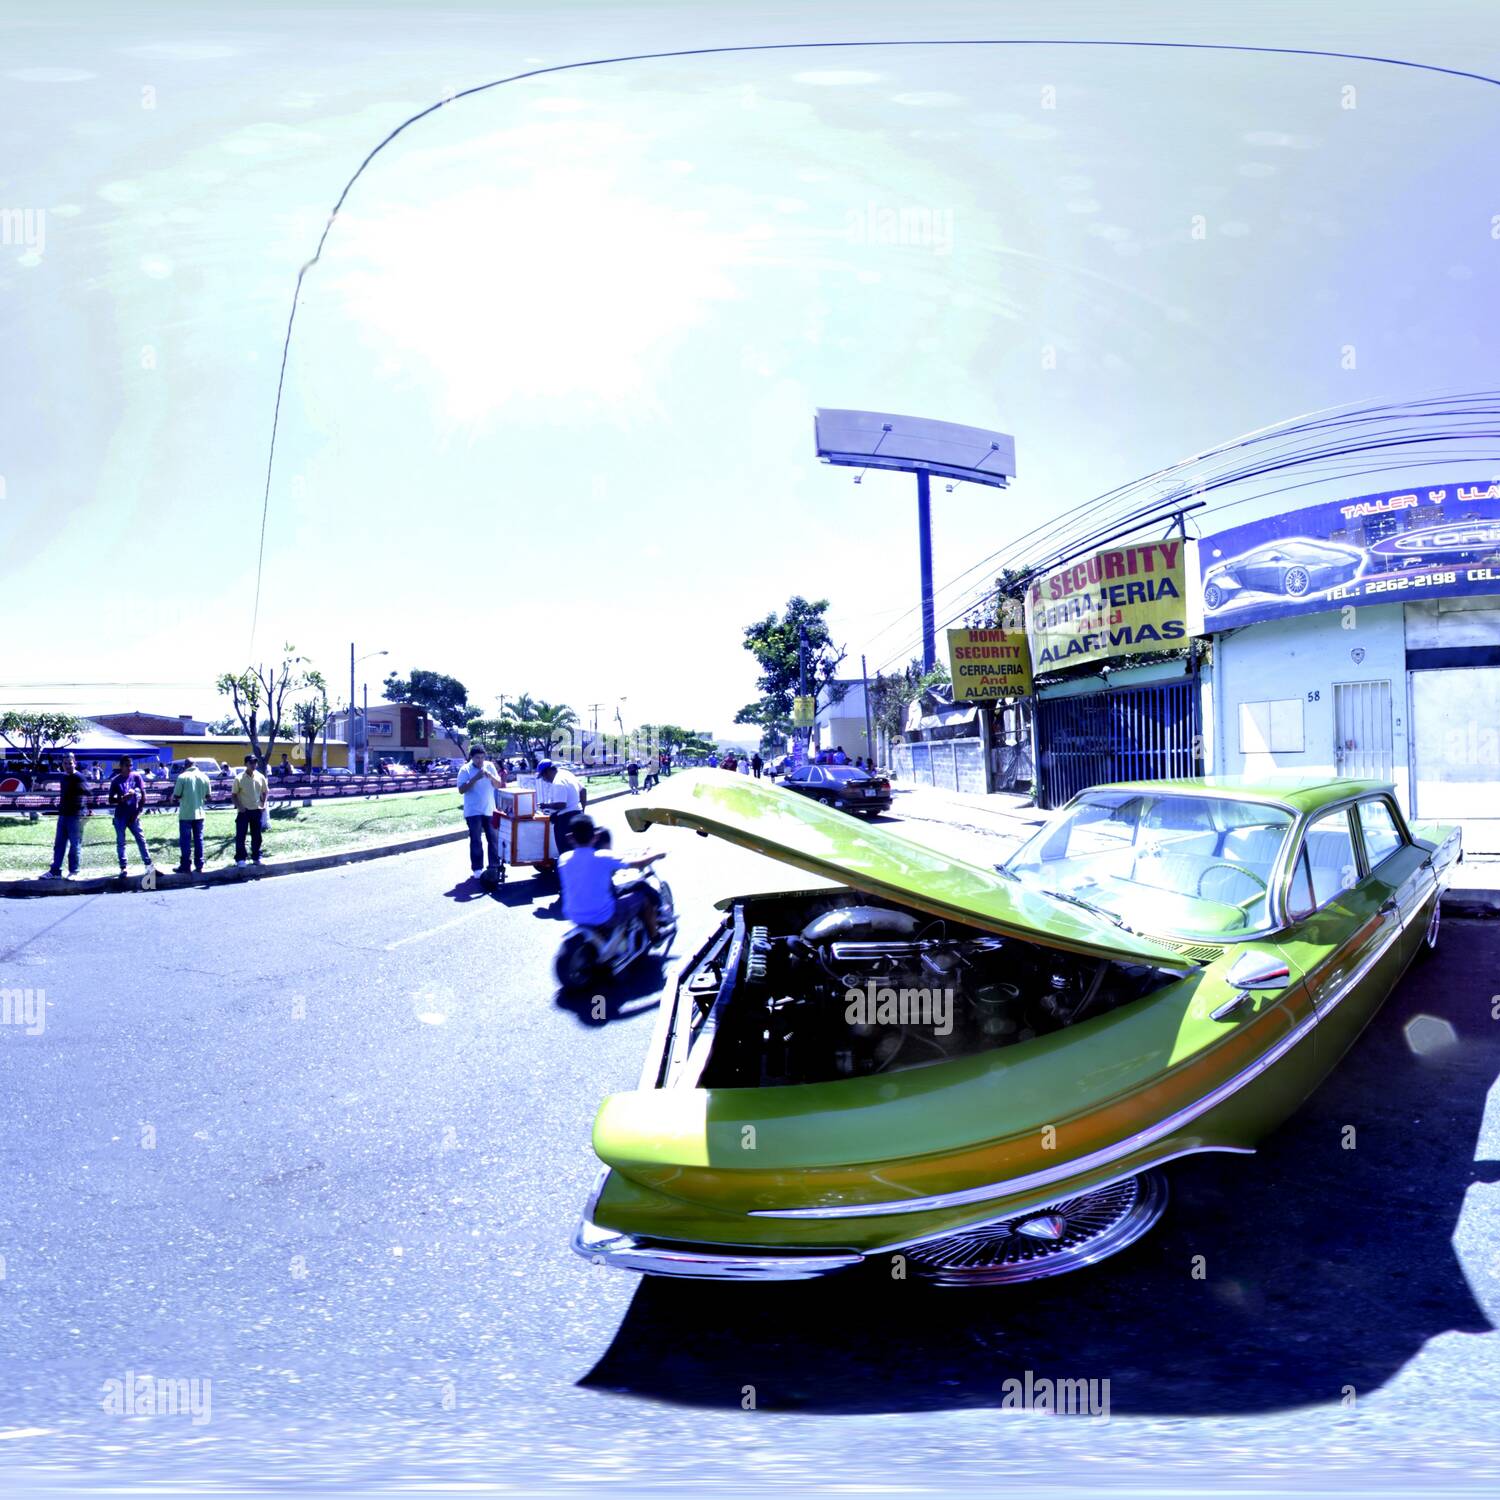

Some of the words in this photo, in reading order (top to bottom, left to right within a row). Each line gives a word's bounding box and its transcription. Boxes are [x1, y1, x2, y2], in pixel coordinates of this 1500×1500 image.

[1341, 494, 1418, 520] TALLER
[1429, 489, 1446, 504] Y
[1049, 541, 1180, 601] SECURITY
[1326, 587, 1361, 601] TEL.:
[1365, 571, 1457, 594] 2262-2198
[1035, 577, 1180, 631] CERRAJERIA
[1077, 609, 1123, 633] And
[969, 630, 1007, 643] HOME
[1039, 620, 1186, 666] ALARMAS
[955, 646, 1020, 659] SECURITY
[959, 664, 1024, 676] CERRAJERIA
[980, 675, 1008, 685] And
[965, 685, 1024, 697] ALARMAS
[1308, 690, 1320, 702] 58
